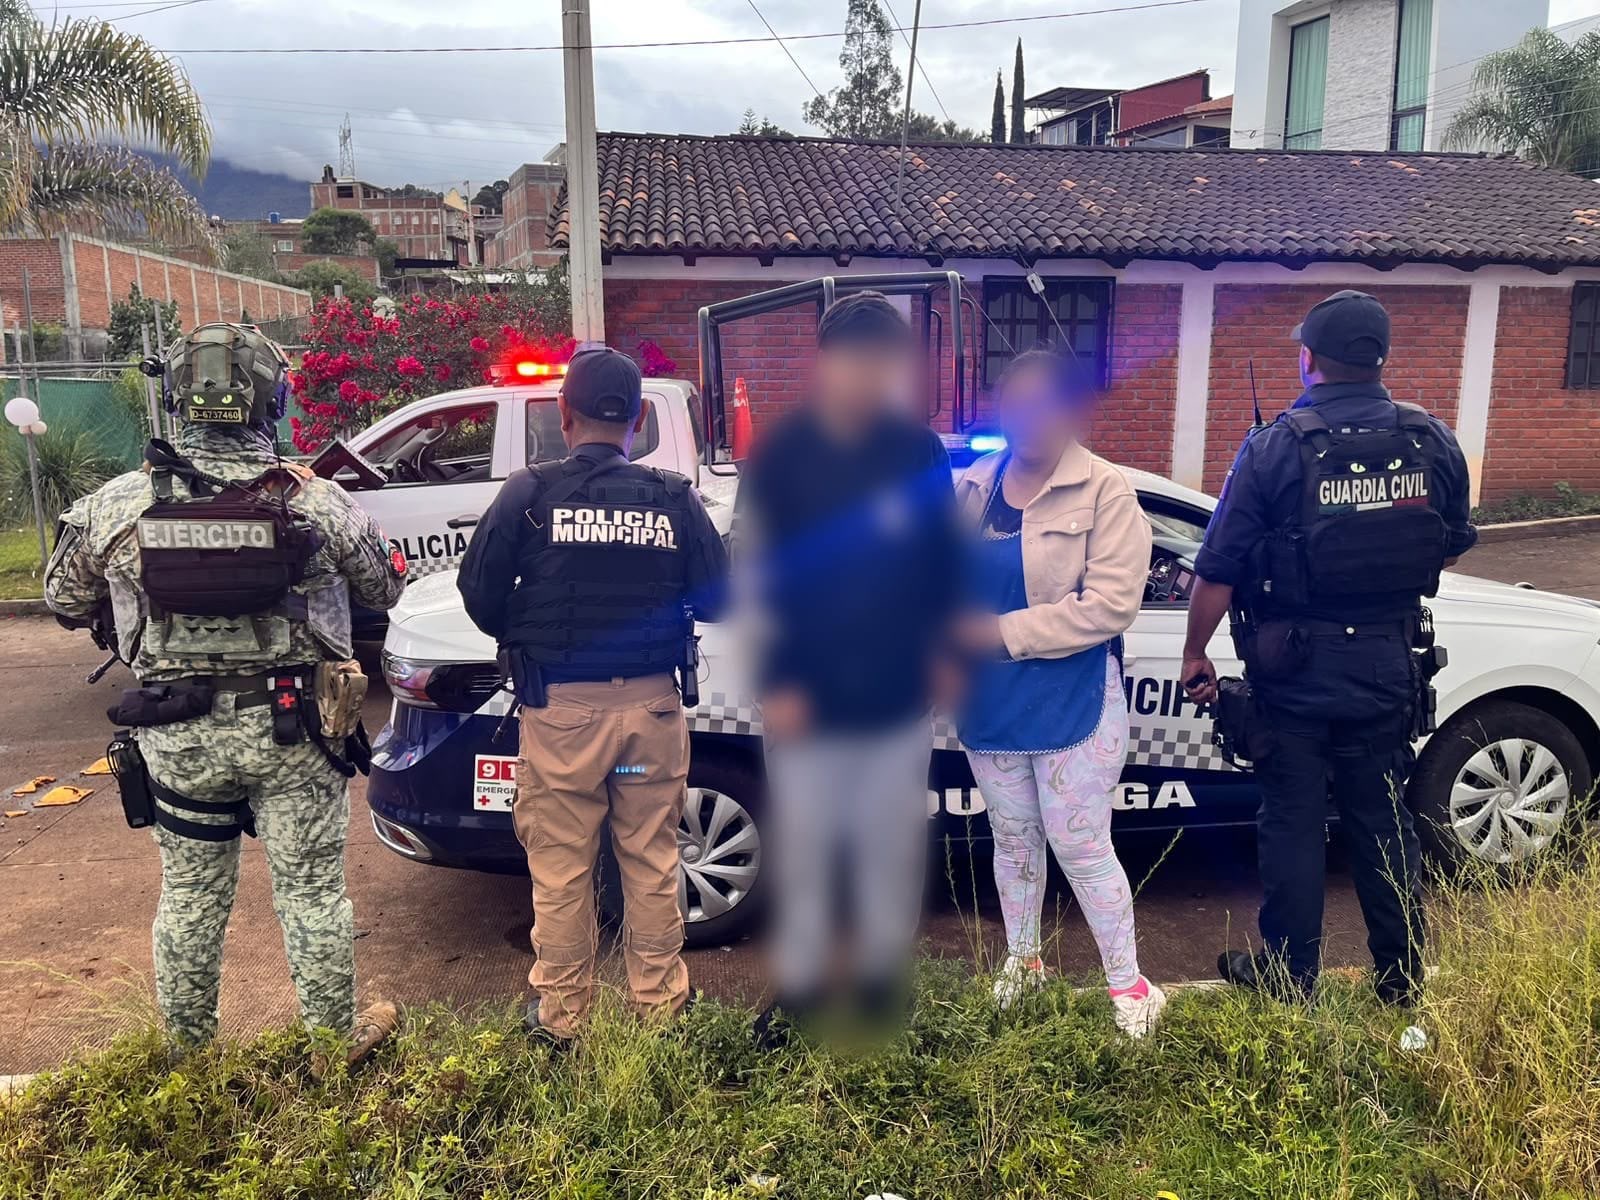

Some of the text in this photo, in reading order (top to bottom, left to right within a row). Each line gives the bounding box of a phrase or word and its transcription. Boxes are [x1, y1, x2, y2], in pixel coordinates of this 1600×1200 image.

[1319, 472, 1428, 505] GUARDIA CIVIL
[552, 523, 678, 549] MUNICIPAL
